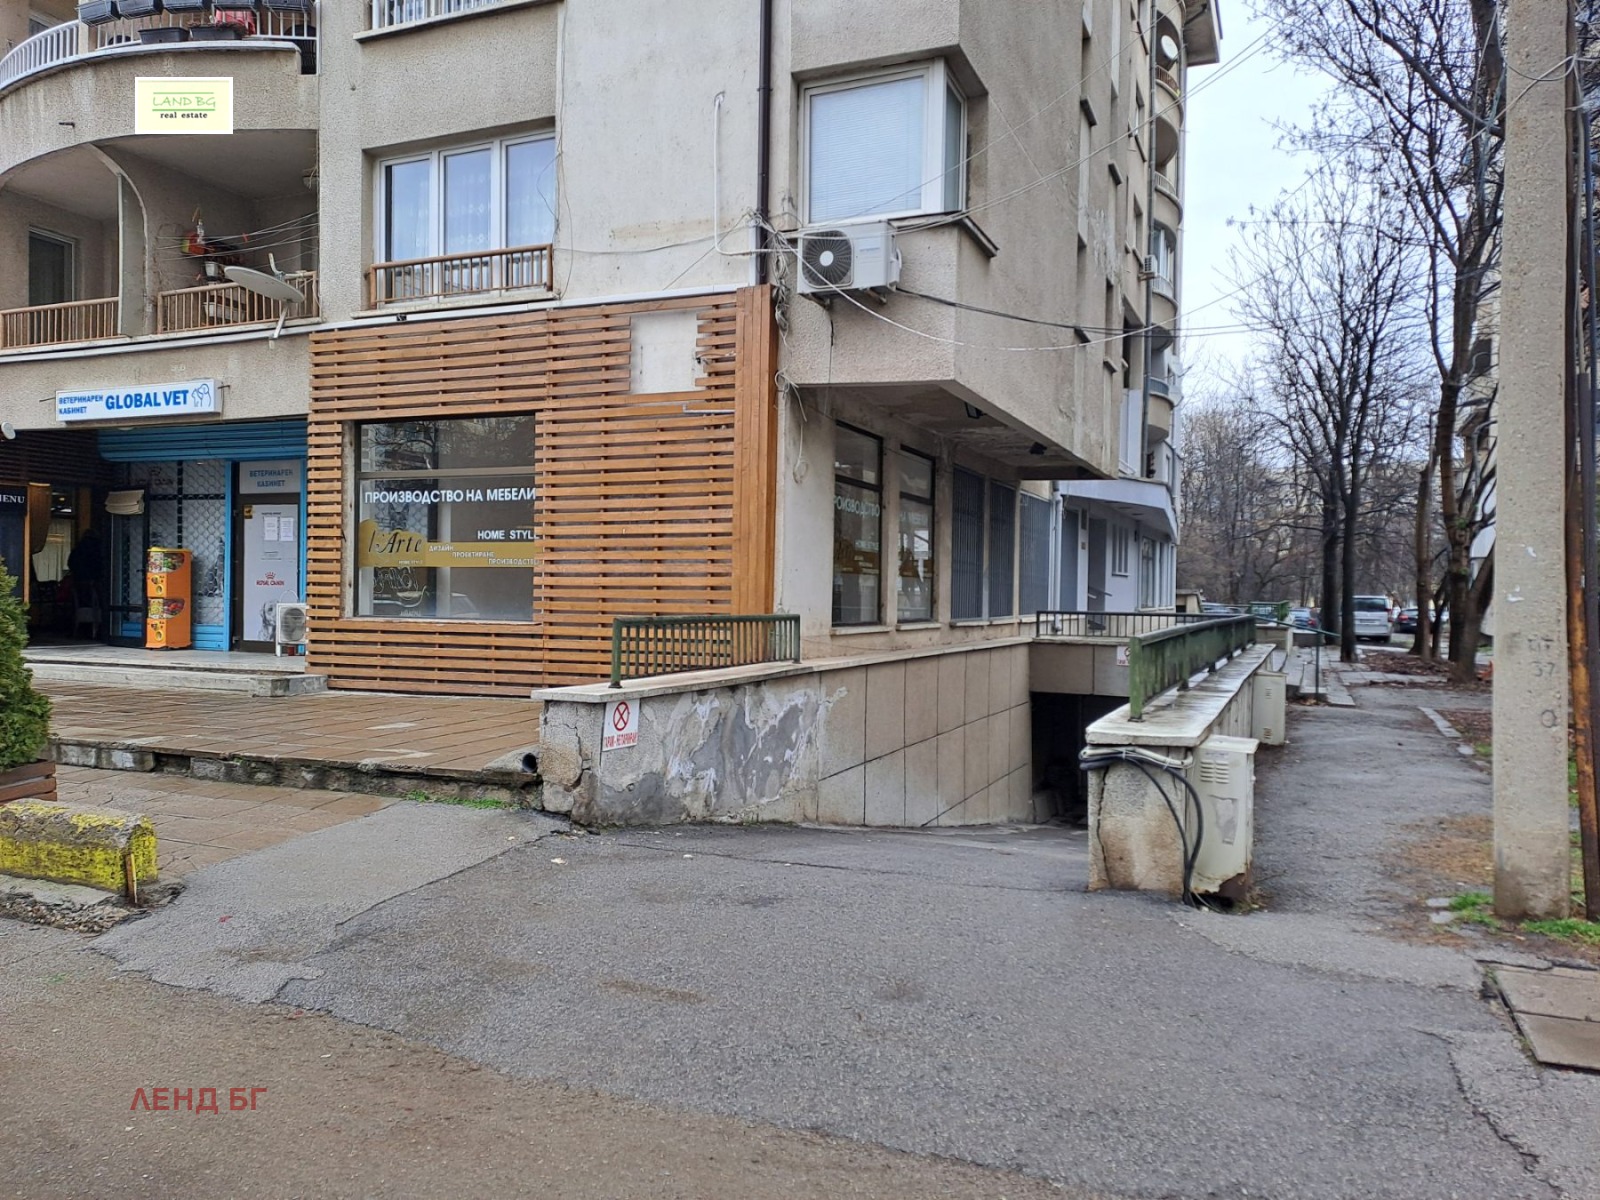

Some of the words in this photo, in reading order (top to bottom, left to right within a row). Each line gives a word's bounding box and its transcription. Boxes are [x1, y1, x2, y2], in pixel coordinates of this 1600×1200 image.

[58, 394, 103, 405] ВЕТЕРИНАРЕН
[105, 392, 161, 410] GLOBAL
[163, 390, 189, 406] VET
[58, 406, 87, 415] КАБИНЕТ
[364, 489, 464, 504] ПРОИЗВОДСТВО
[466, 488, 483, 501] НА
[486, 487, 537, 501] МЕБЕЛИ
[477, 529, 505, 540] HOME
[428, 544, 454, 552] ДИЗАЙН
